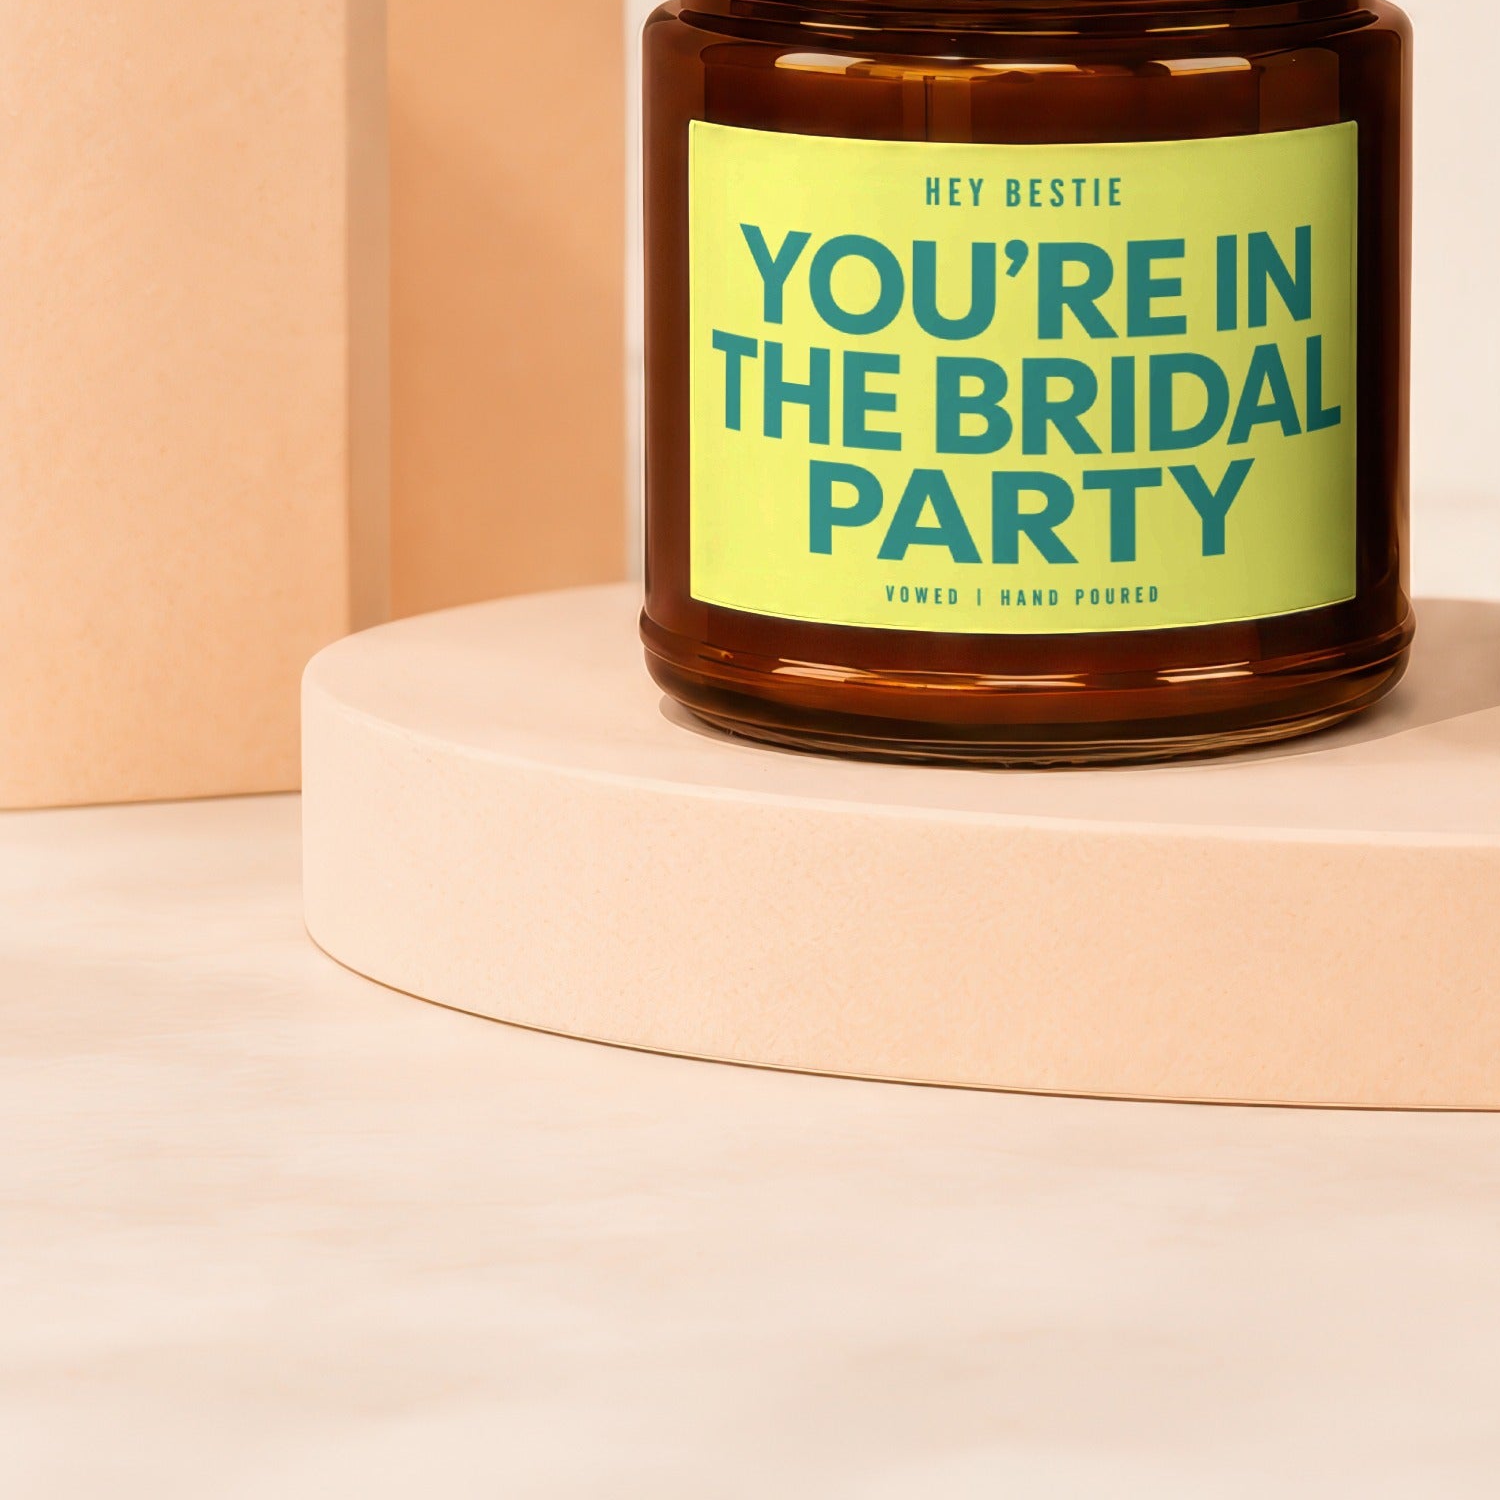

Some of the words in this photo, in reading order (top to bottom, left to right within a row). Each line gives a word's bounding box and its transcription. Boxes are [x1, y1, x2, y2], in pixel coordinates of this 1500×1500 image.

[925, 177, 984, 207] HEY
[1006, 177, 1121, 208] BESTIE
[739, 223, 1188, 341] YOU’RE
[1216, 224, 1313, 333] IN
[712, 328, 902, 452] THE
[935, 334, 1342, 456] BRIDAL
[809, 457, 1255, 565] PARTY
[885, 585, 958, 605] VOWED
[1000, 589, 1058, 606] HAND
[1075, 585, 1158, 605] POURED
